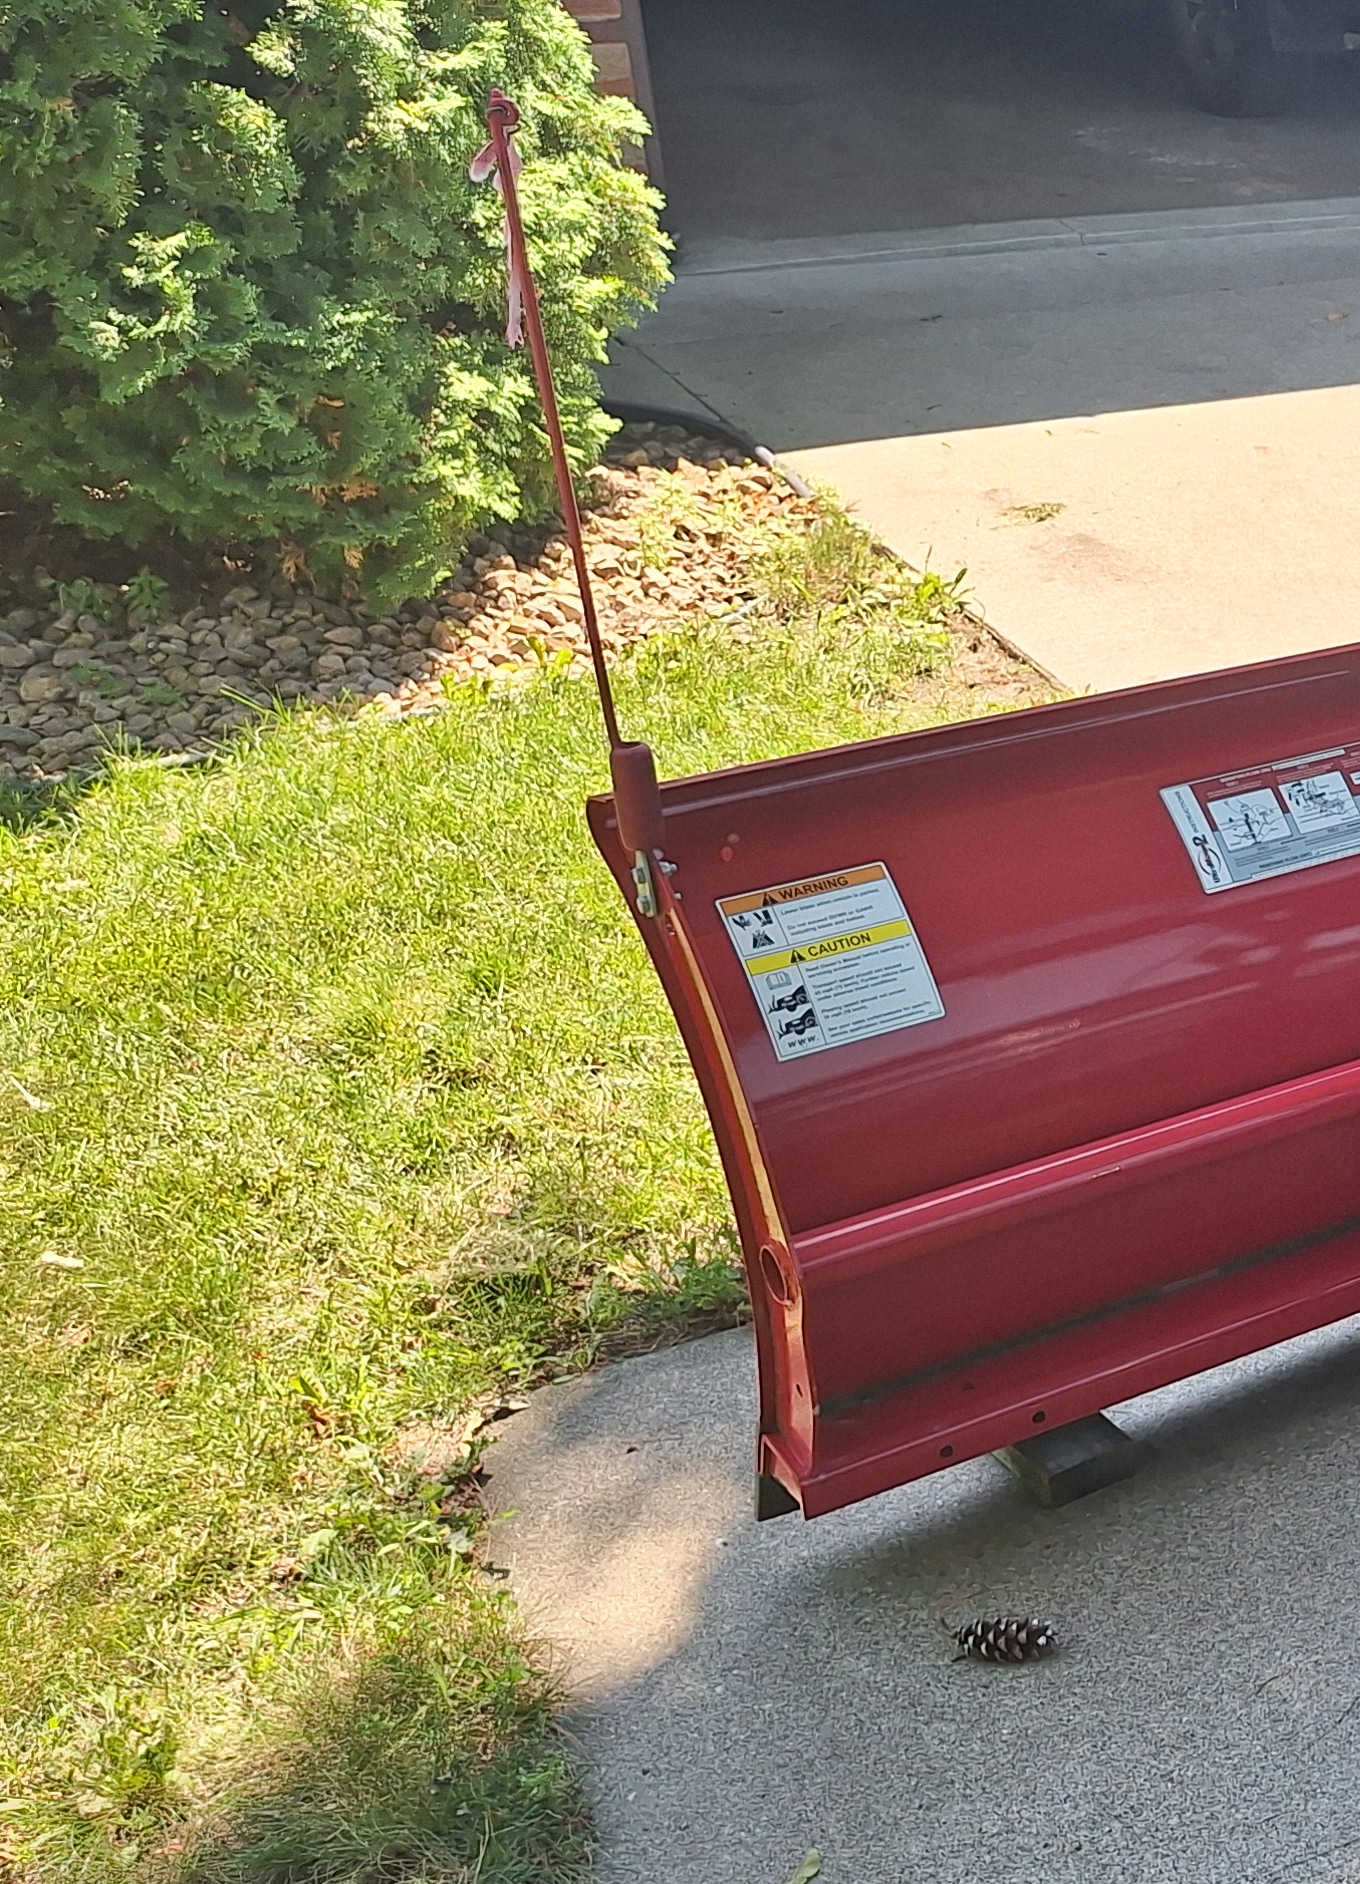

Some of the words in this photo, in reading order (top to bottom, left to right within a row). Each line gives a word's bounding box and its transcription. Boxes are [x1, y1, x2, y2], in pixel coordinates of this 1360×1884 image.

[1190, 834, 1208, 847] 2
[778, 876, 849, 899] WARNING
[806, 932, 872, 957] CAUTION
